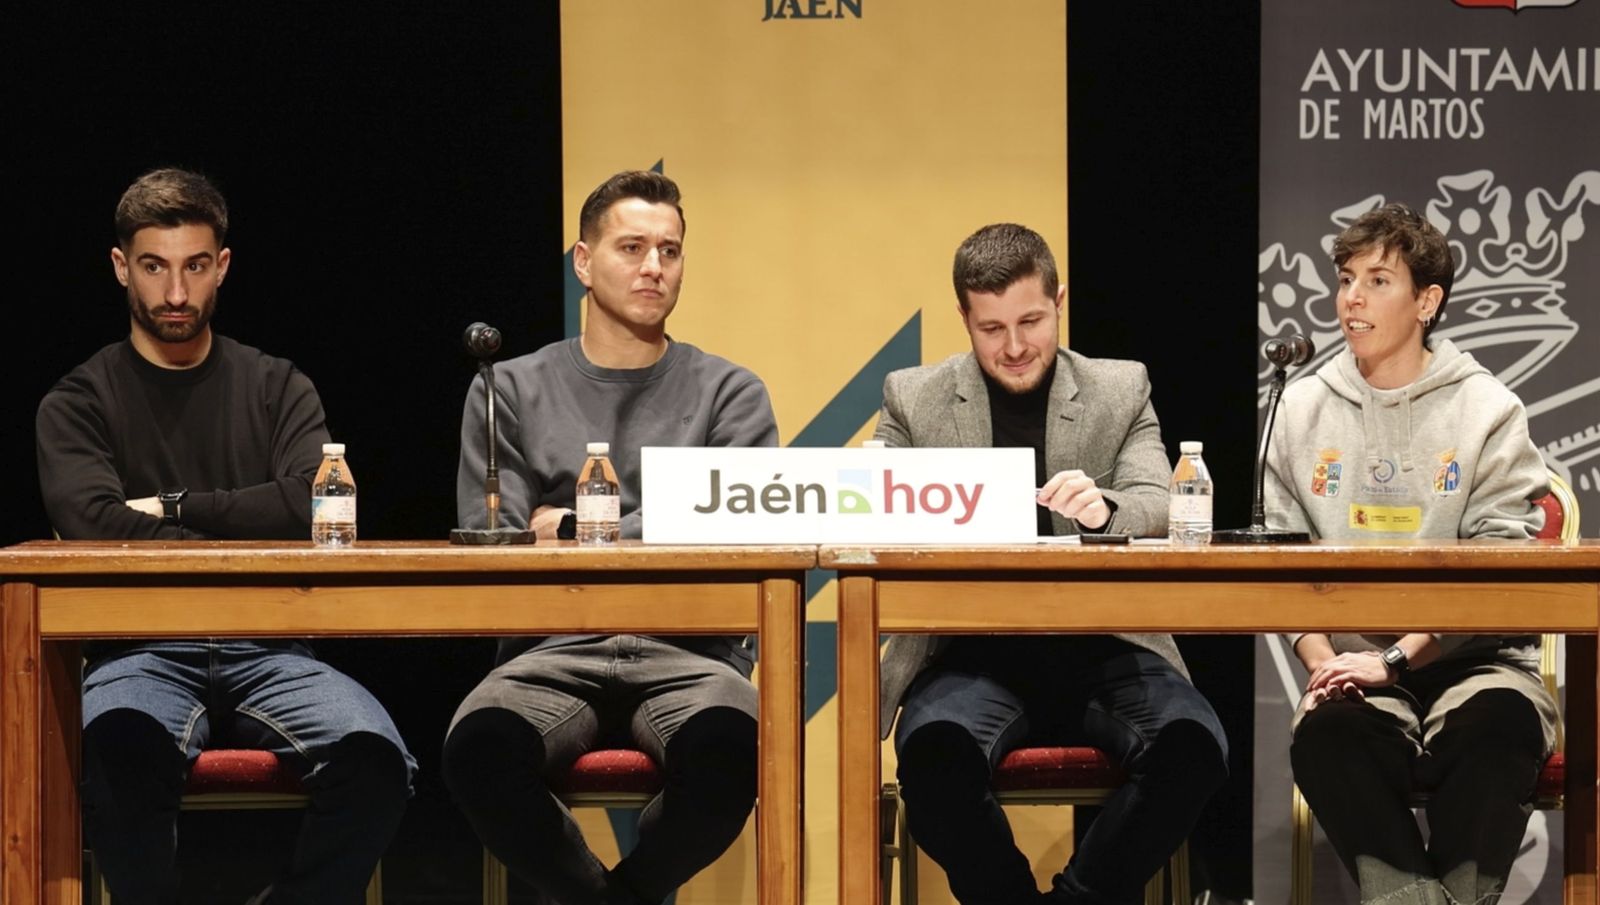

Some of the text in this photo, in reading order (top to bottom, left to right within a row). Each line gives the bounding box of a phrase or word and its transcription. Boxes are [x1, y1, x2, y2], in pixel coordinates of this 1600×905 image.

[1299, 97, 1485, 140] DE MARTOS
[693, 468, 985, 526] Jaén hoy
